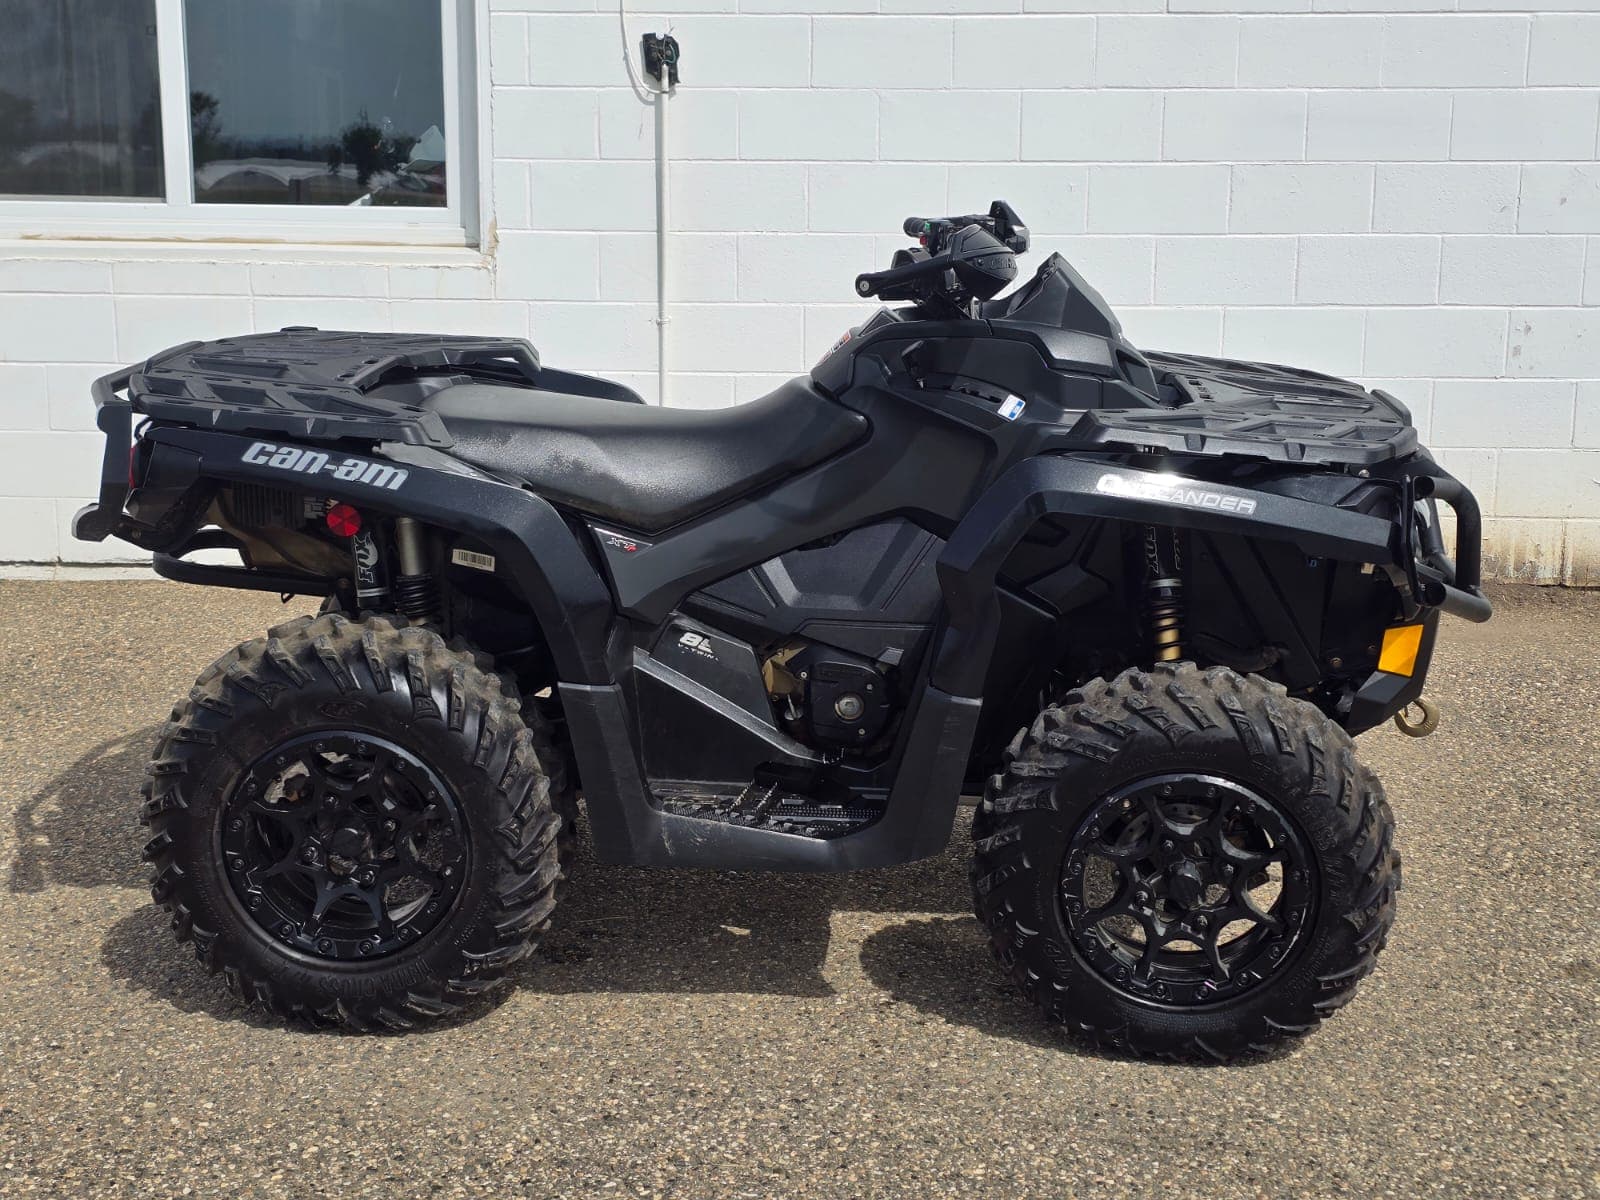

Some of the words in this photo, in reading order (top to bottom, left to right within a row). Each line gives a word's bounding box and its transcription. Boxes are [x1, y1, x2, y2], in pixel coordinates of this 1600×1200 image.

[241, 442, 408, 491] can-am
[1096, 473, 1257, 515] OLANDER
[353, 532, 376, 583] FOX
